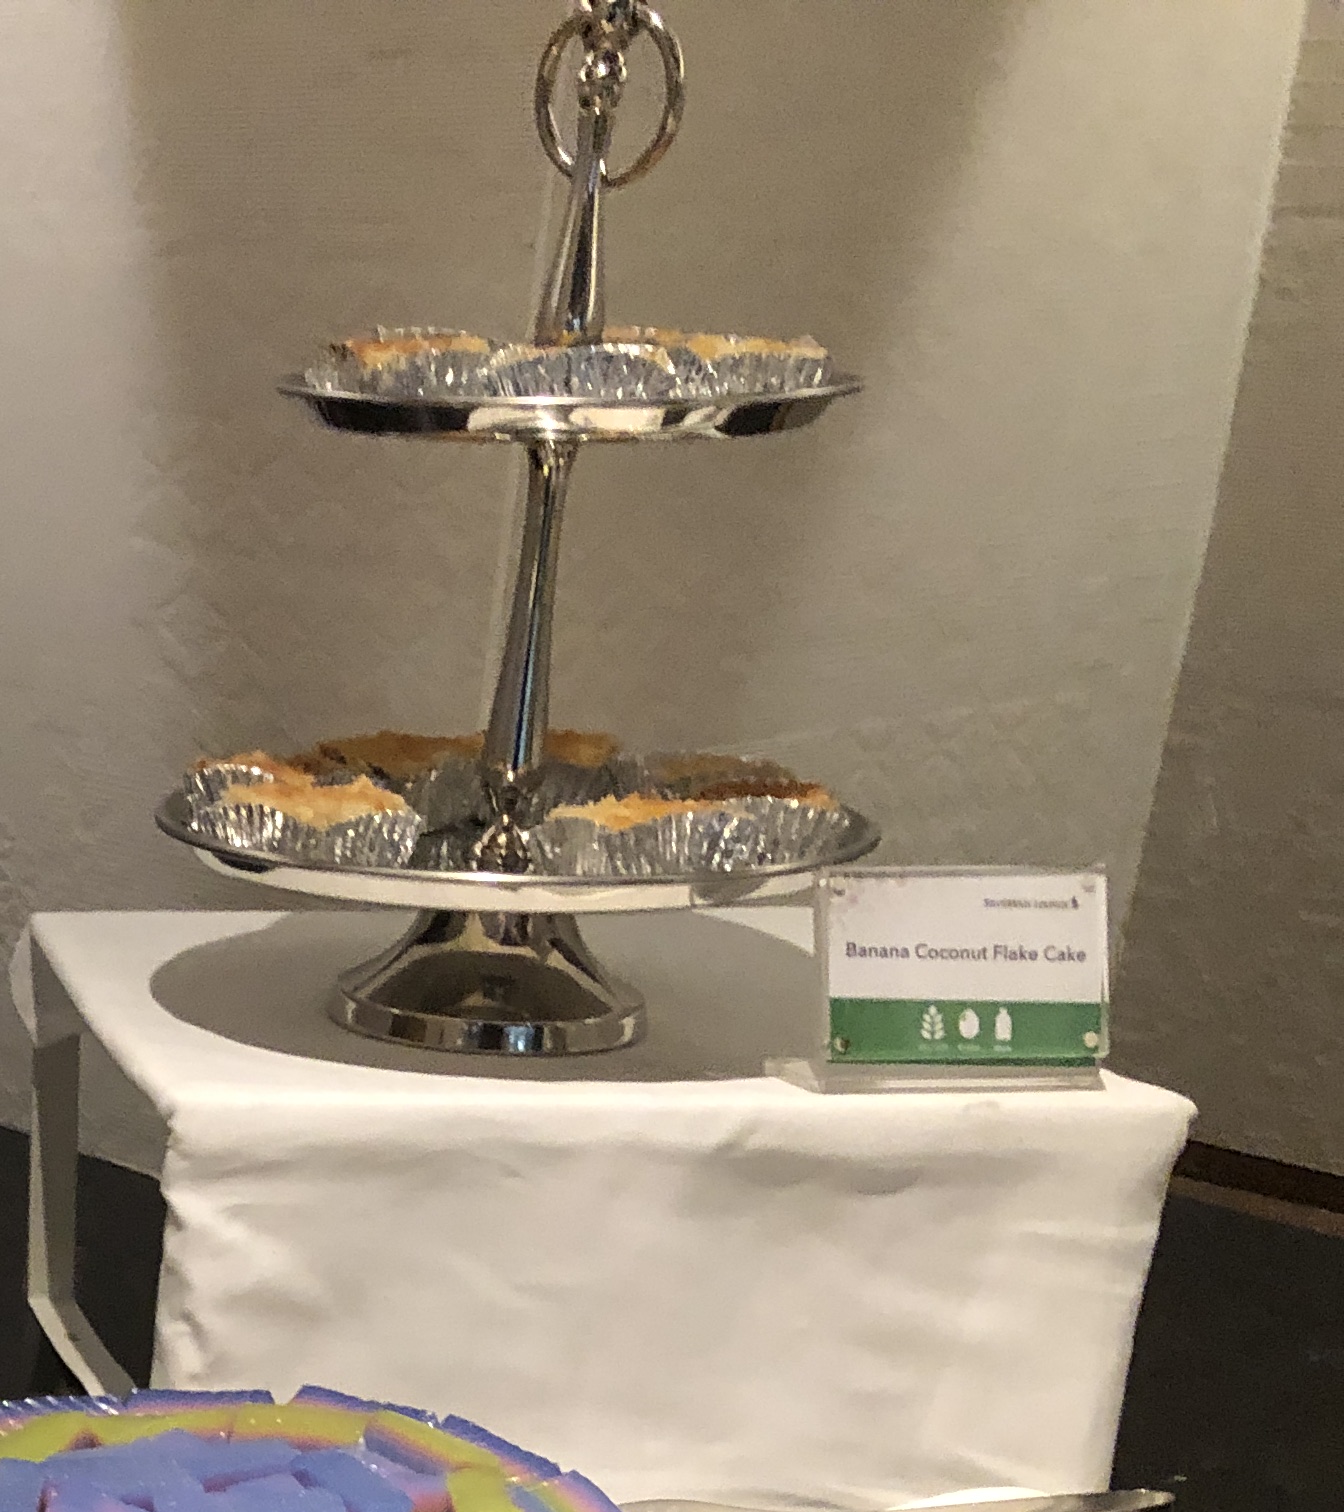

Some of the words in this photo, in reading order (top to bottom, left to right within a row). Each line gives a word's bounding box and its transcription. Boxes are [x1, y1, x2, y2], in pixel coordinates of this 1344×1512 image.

[845, 941, 910, 959] Banana
[915, 943, 988, 961] Coconut
[992, 944, 1038, 962] Flake
[1043, 945, 1087, 963] Cake
